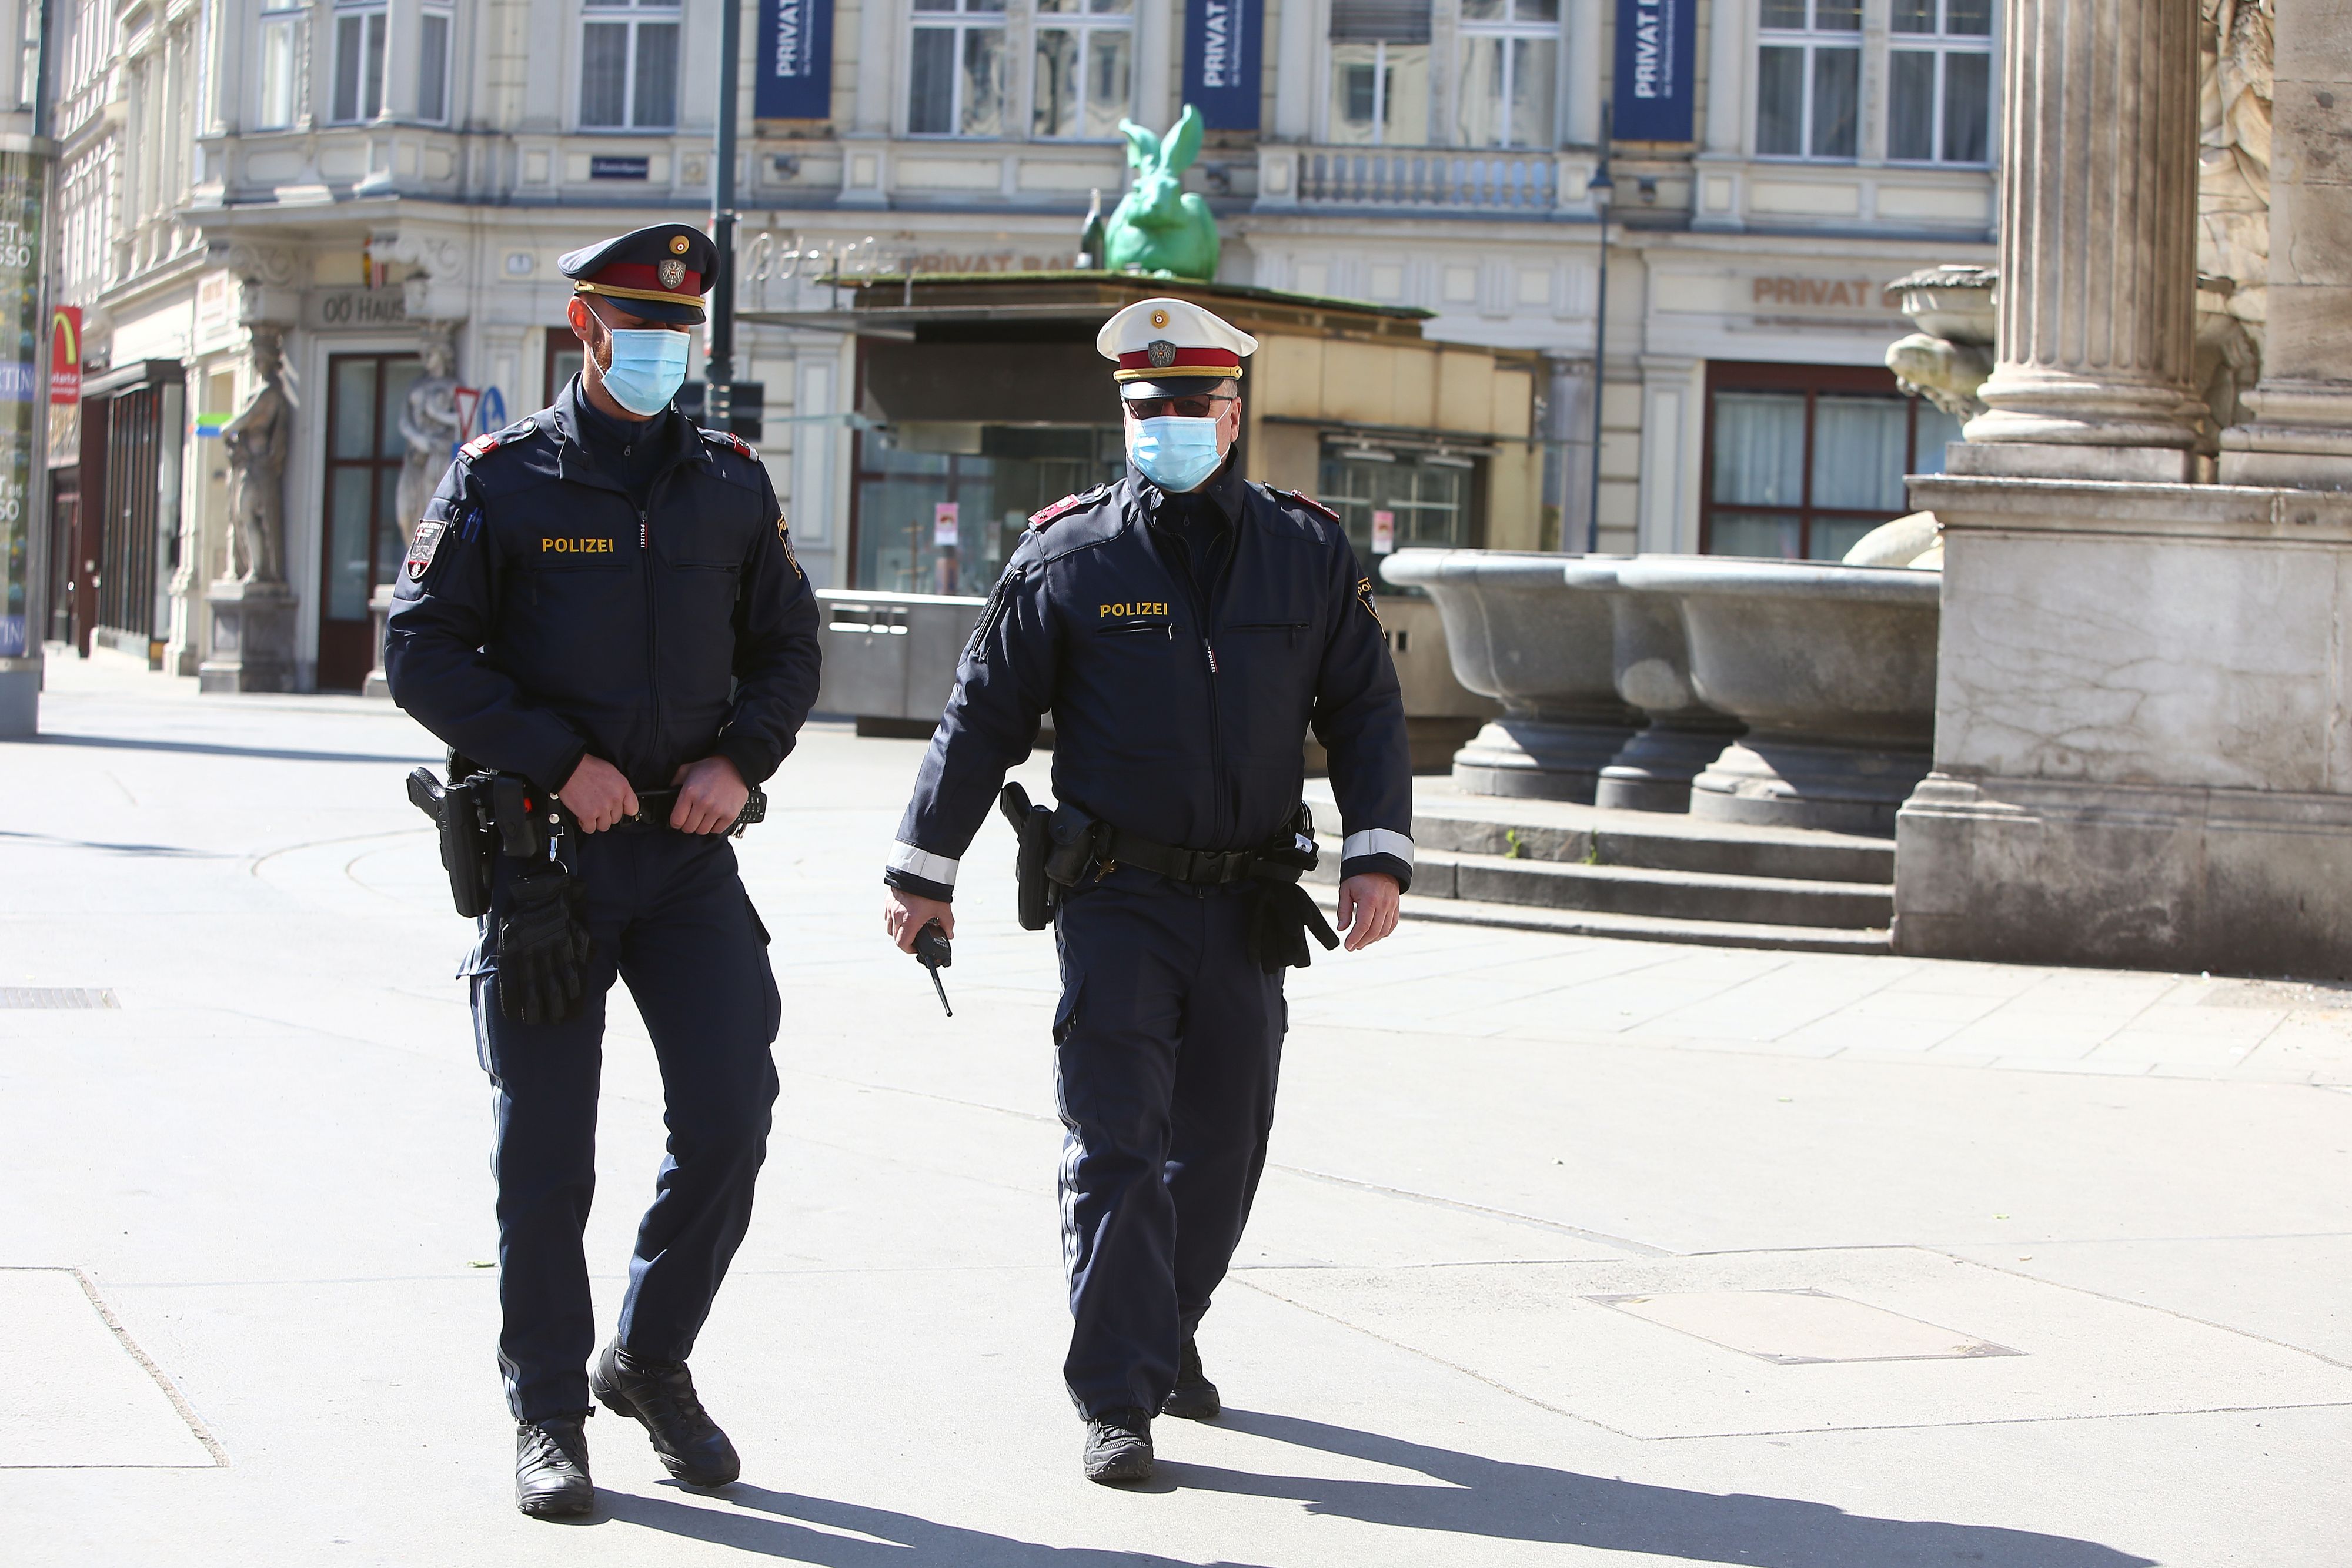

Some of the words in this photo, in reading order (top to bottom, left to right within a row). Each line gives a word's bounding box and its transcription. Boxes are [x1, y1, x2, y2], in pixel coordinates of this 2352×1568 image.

[1203, 0, 1228, 87] PRIVAT
[1635, 9, 1659, 99] PRIVAT
[1752, 276, 1872, 307] PRIVAT
[542, 538, 614, 553] POLIZEI
[1100, 602, 1168, 618] POLIZEI
[1207, 650, 1217, 673] POLIZEI
